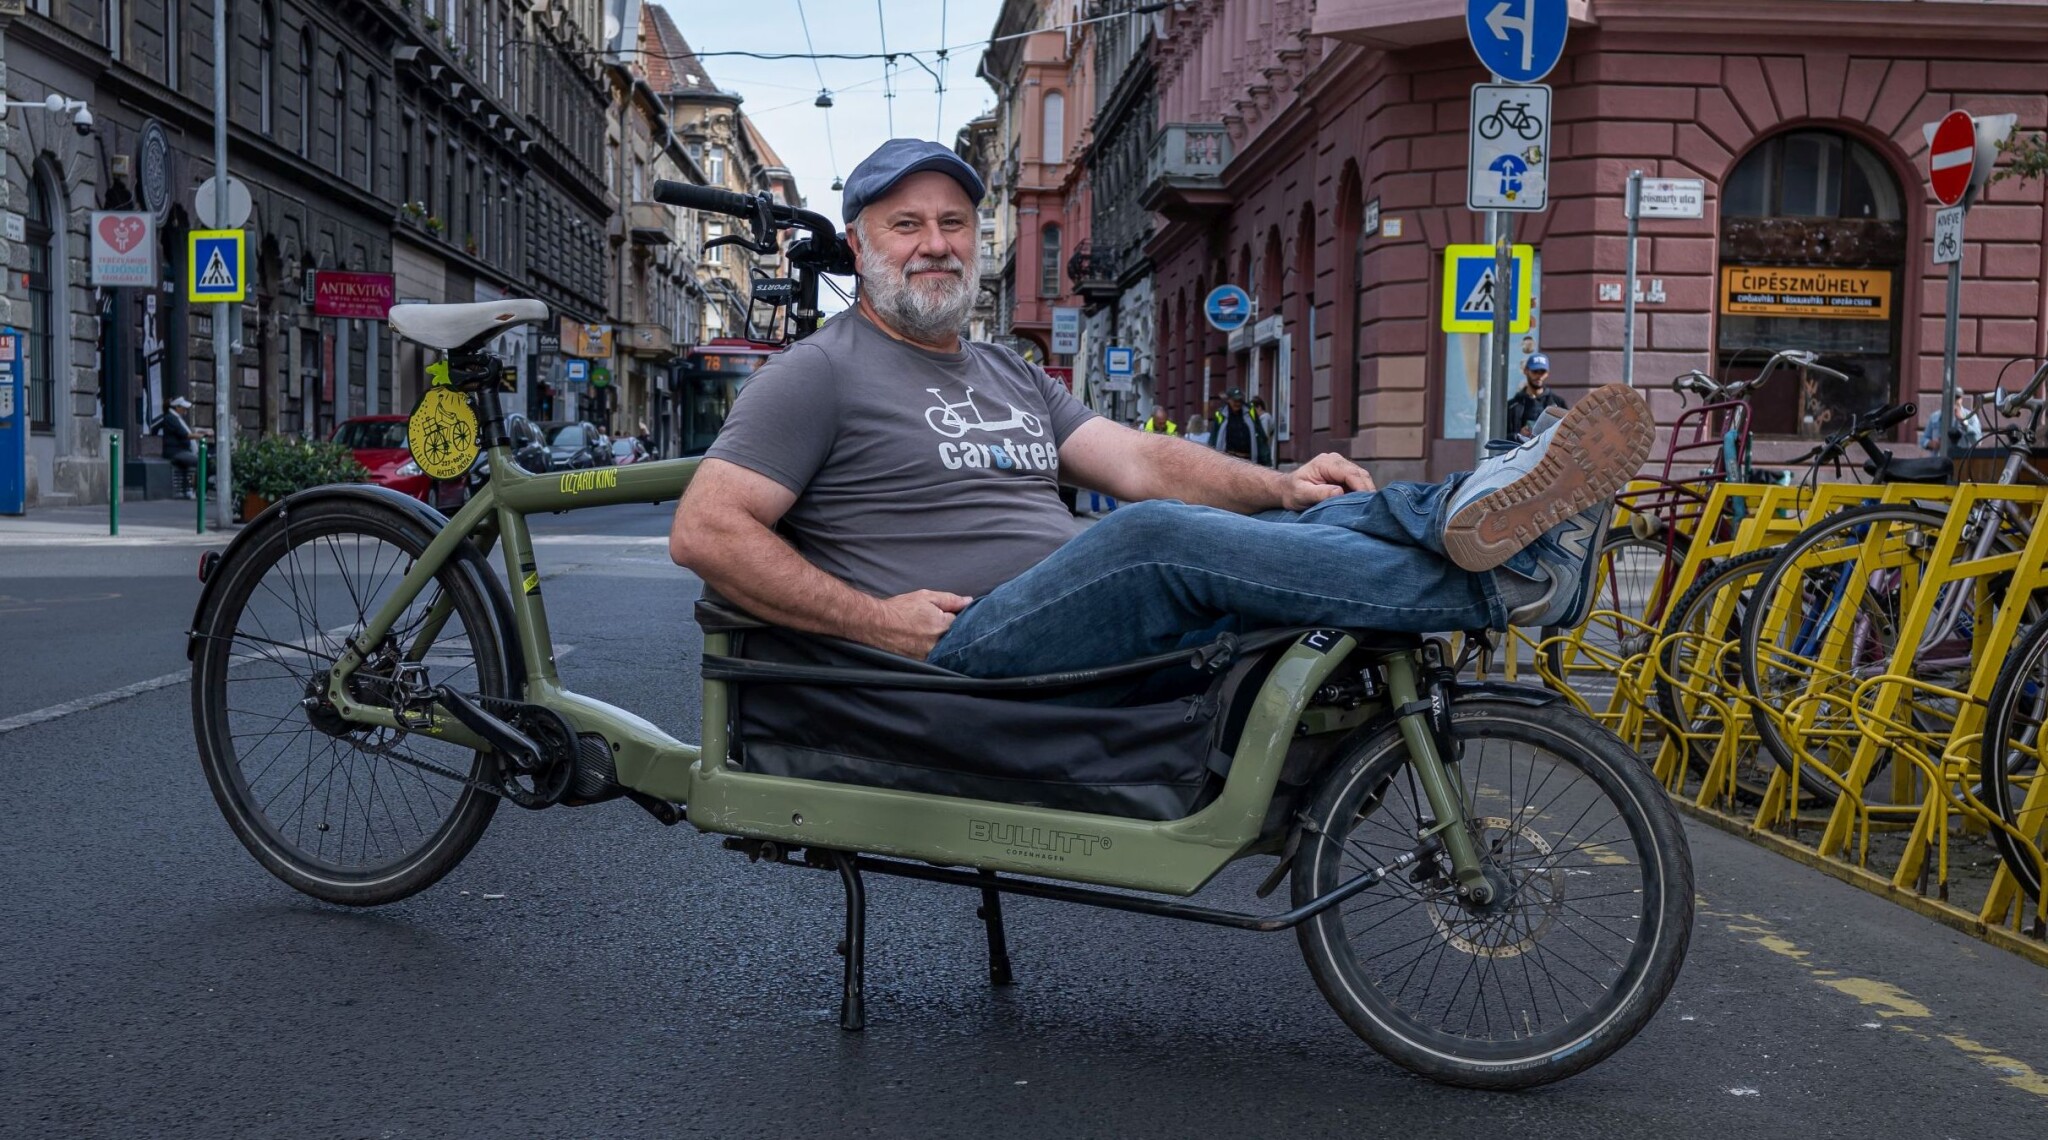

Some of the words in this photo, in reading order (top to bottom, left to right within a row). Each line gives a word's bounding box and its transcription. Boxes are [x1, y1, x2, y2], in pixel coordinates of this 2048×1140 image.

[1680, 194, 1697, 204] utca
[320, 281, 391, 299] ANTIKVITÁS
[756, 283, 792, 291] SPORTS
[704, 355, 721, 372] 78
[938, 438, 1058, 471] carefree
[561, 471, 596, 495] LIZZARD
[596, 468, 618, 489] KING
[1430, 694, 1441, 717] AXA
[1006, 848, 1065, 862] COPENHAGEN
